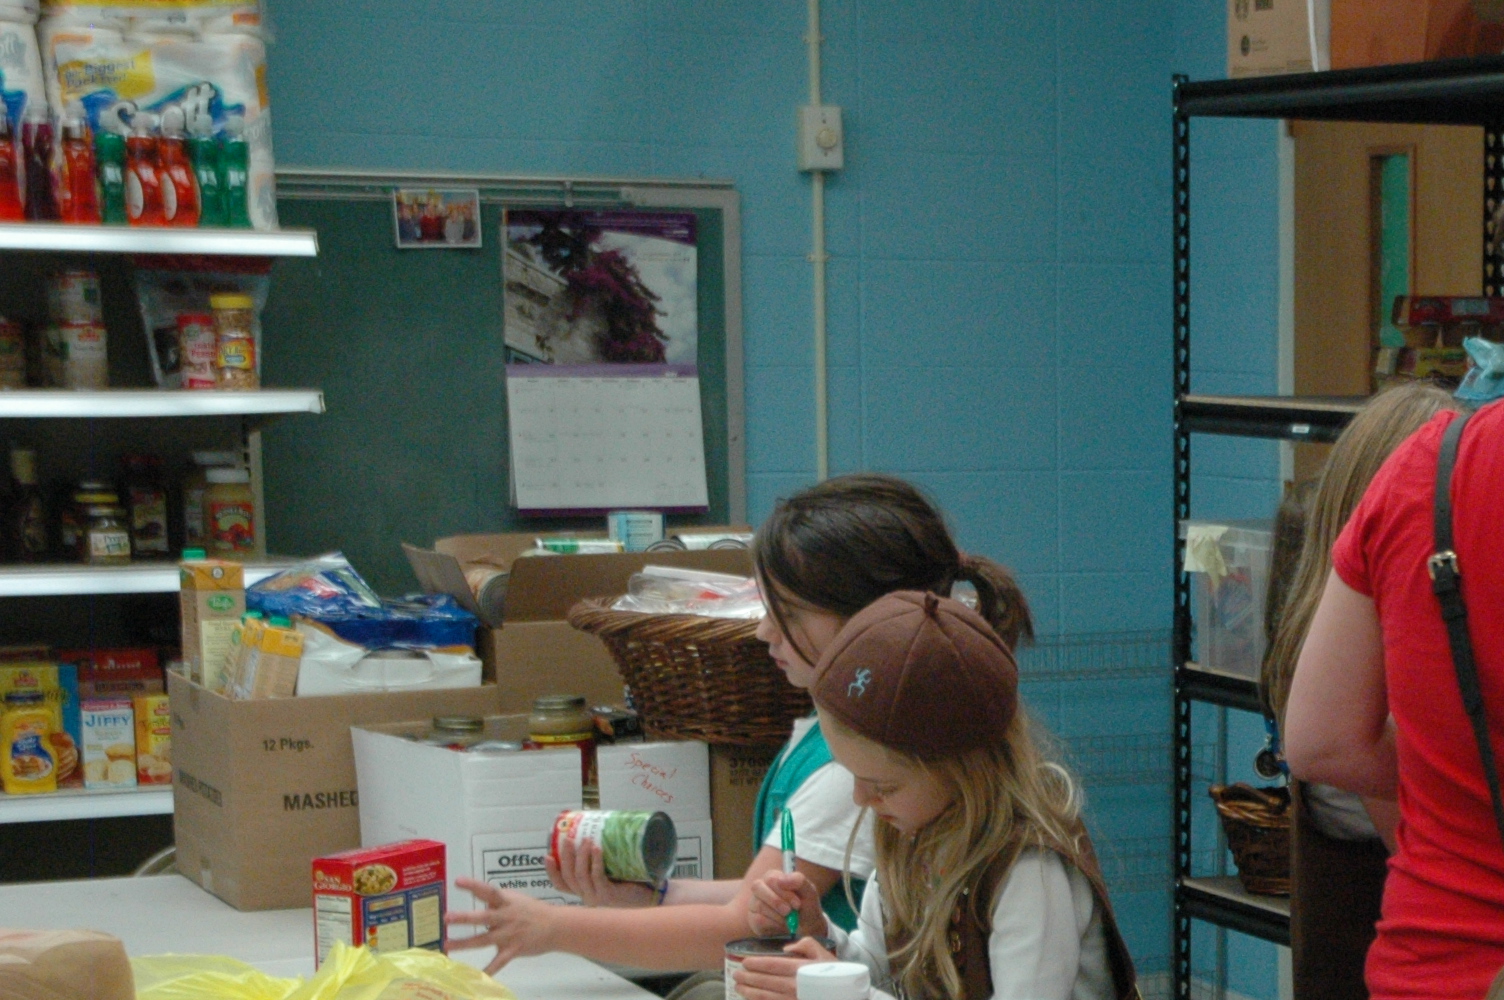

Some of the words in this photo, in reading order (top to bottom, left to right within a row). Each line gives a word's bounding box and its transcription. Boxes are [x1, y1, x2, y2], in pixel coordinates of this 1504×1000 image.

[97, 80, 217, 141] Stt
[262, 739, 276, 751] 12
[279, 736, 315, 753] Pkgs.
[624, 752, 678, 780] Special
[497, 854, 546, 868] Office
[499, 878, 528, 889] white
